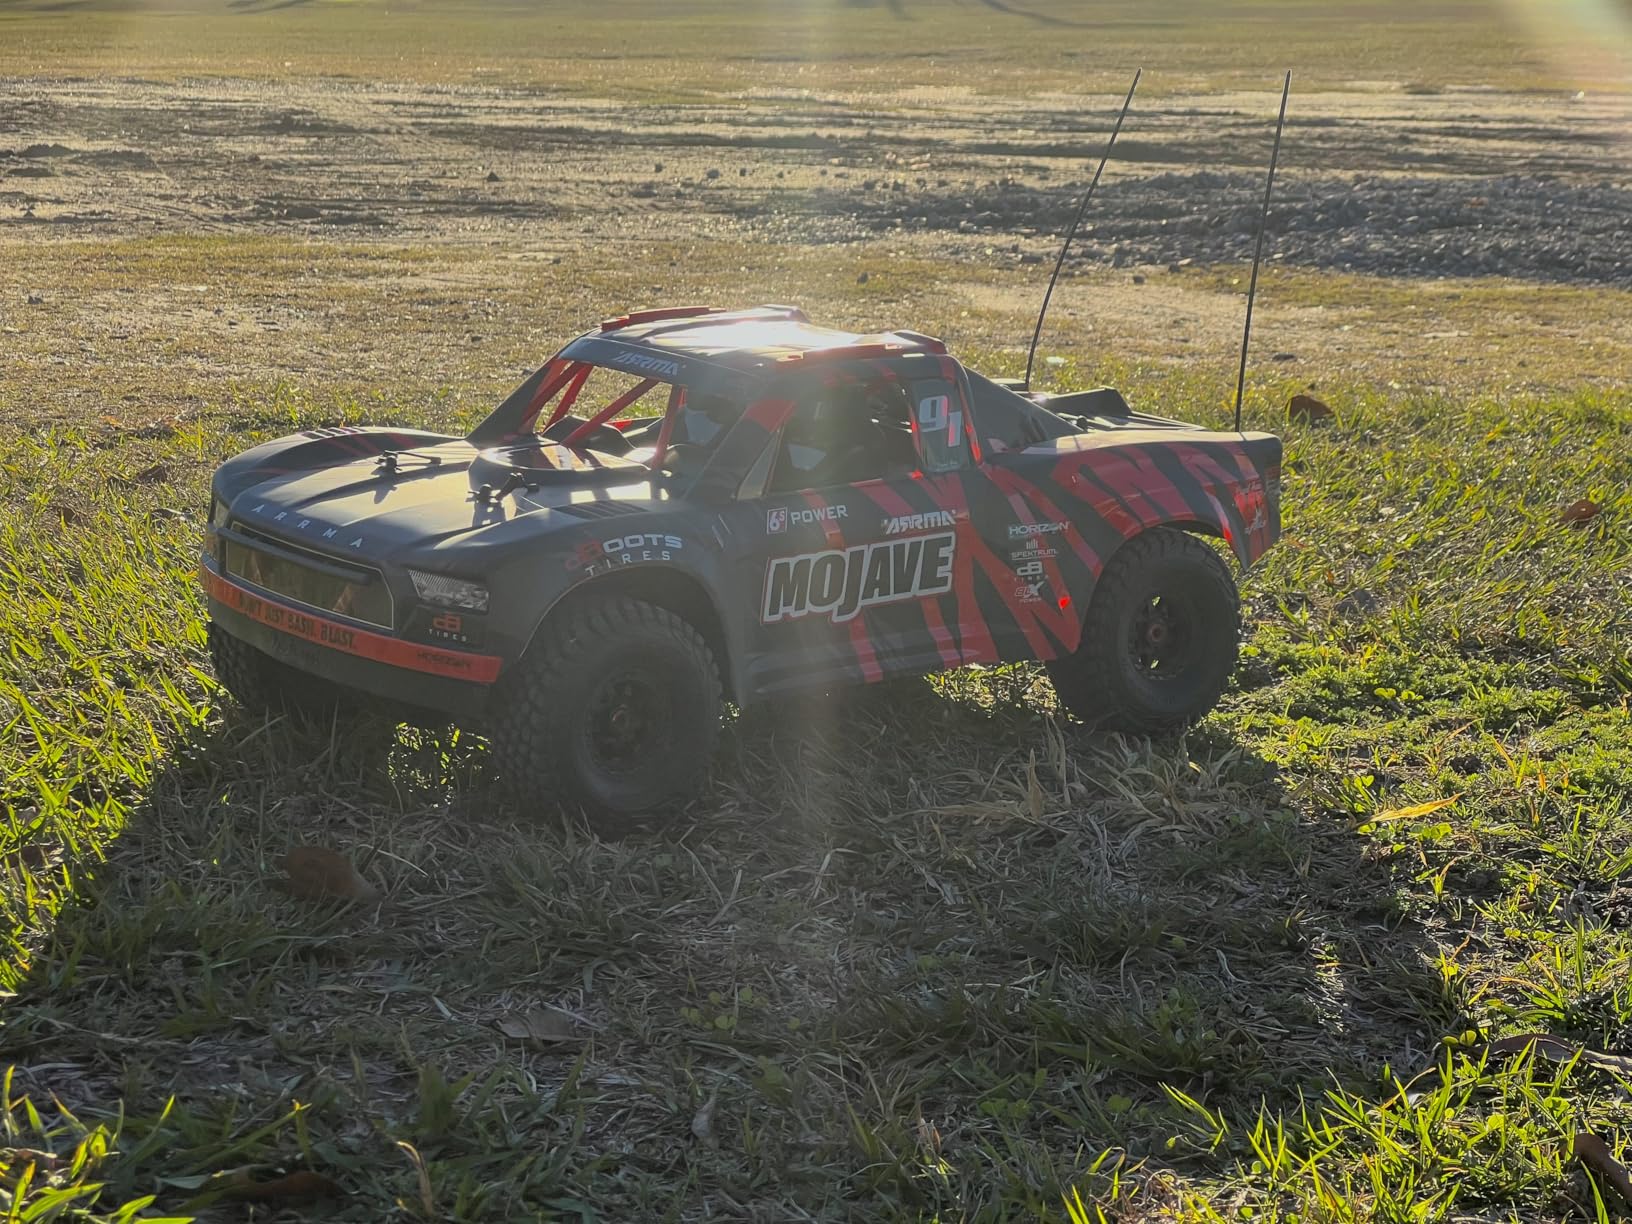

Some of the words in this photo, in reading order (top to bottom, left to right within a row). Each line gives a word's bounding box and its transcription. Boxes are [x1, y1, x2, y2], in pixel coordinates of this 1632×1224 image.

[250, 503, 364, 549] ARRMA
[790, 504, 849, 526] POWER
[584, 550, 671, 577] TIRES
[762, 531, 957, 624] MOJAVE
